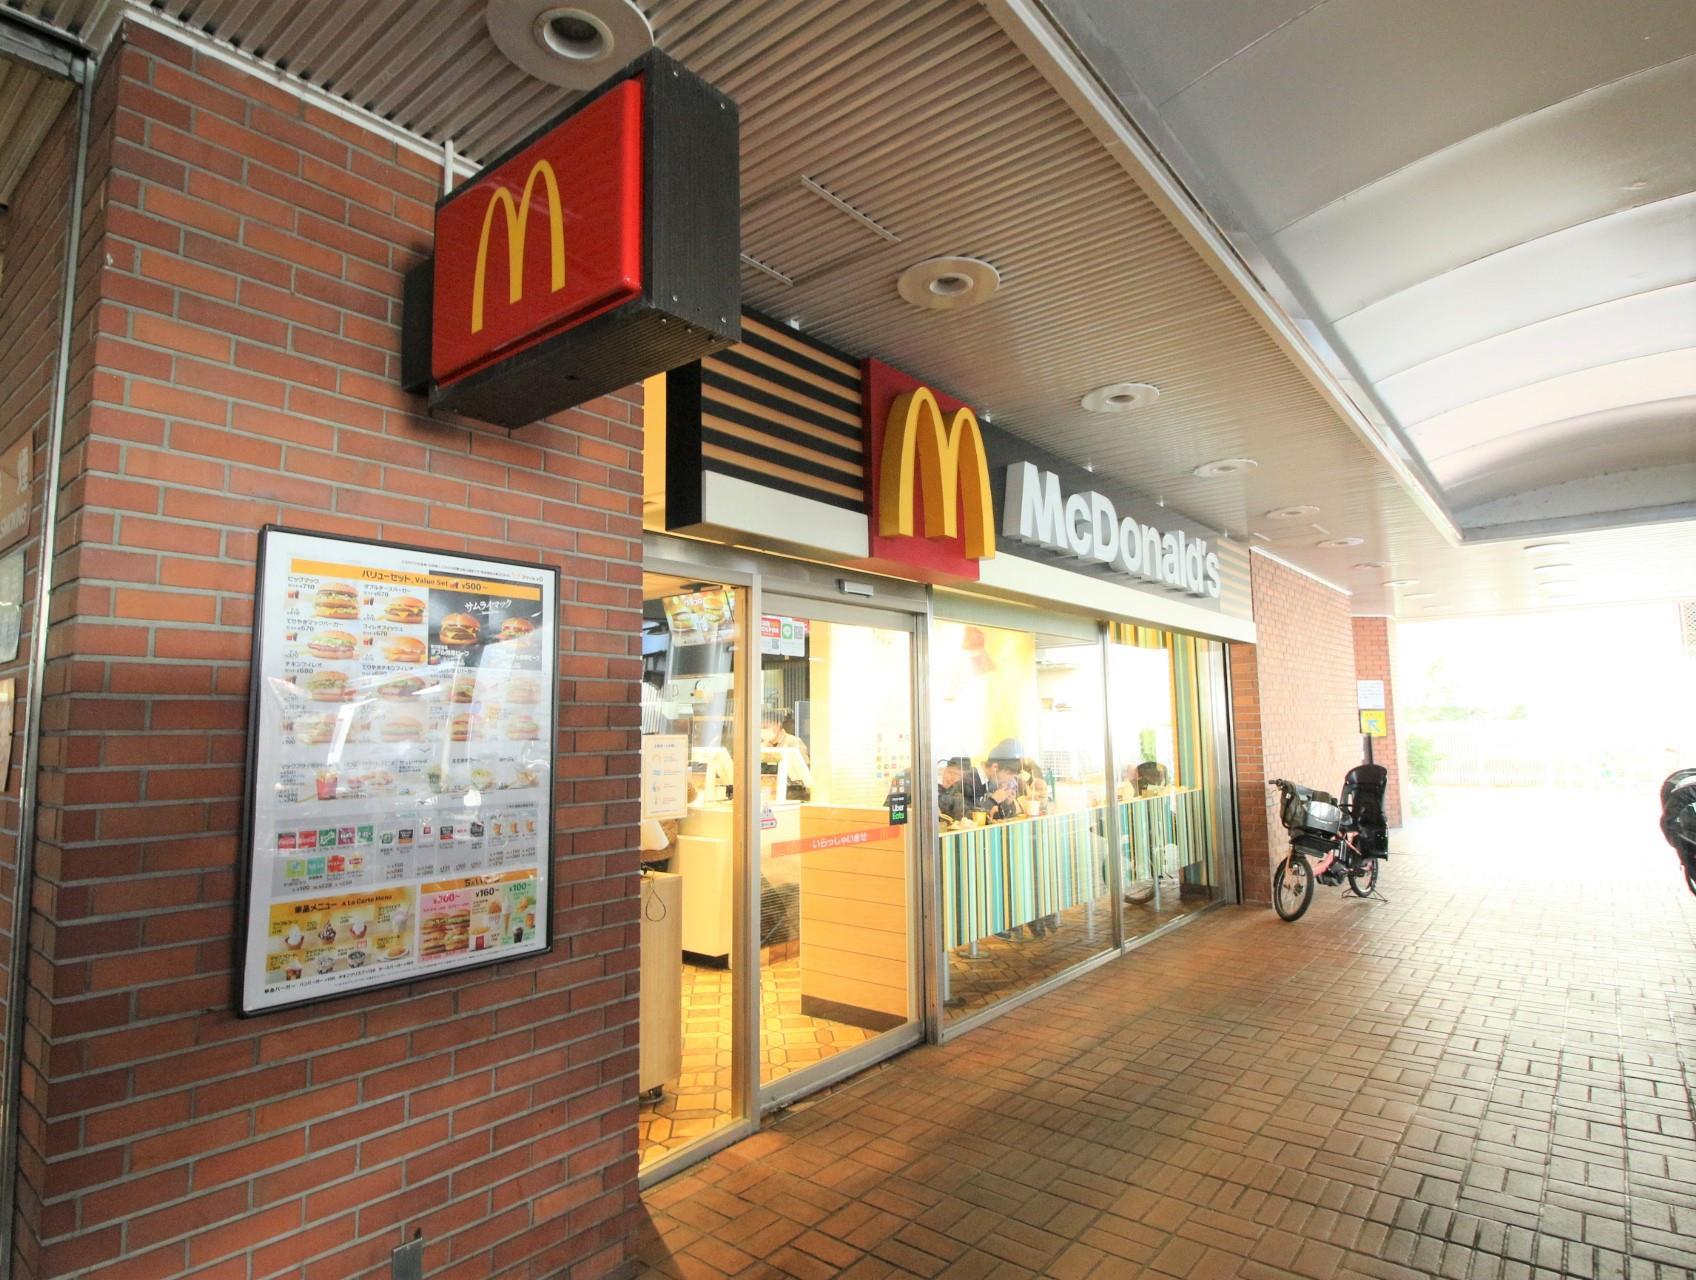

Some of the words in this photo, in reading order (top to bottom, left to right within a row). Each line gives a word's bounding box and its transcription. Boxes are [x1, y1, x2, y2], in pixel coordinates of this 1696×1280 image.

[1002, 460, 1220, 599] McDonald's
[361, 568, 411, 583] バリューセット
[415, 576, 435, 586] Value
[436, 579, 448, 588] Set
[464, 599, 512, 613] サムライマック
[891, 803, 905, 812] Uber
[891, 812, 905, 821] Eats
[812, 832, 868, 849] いらっしゃいませ
